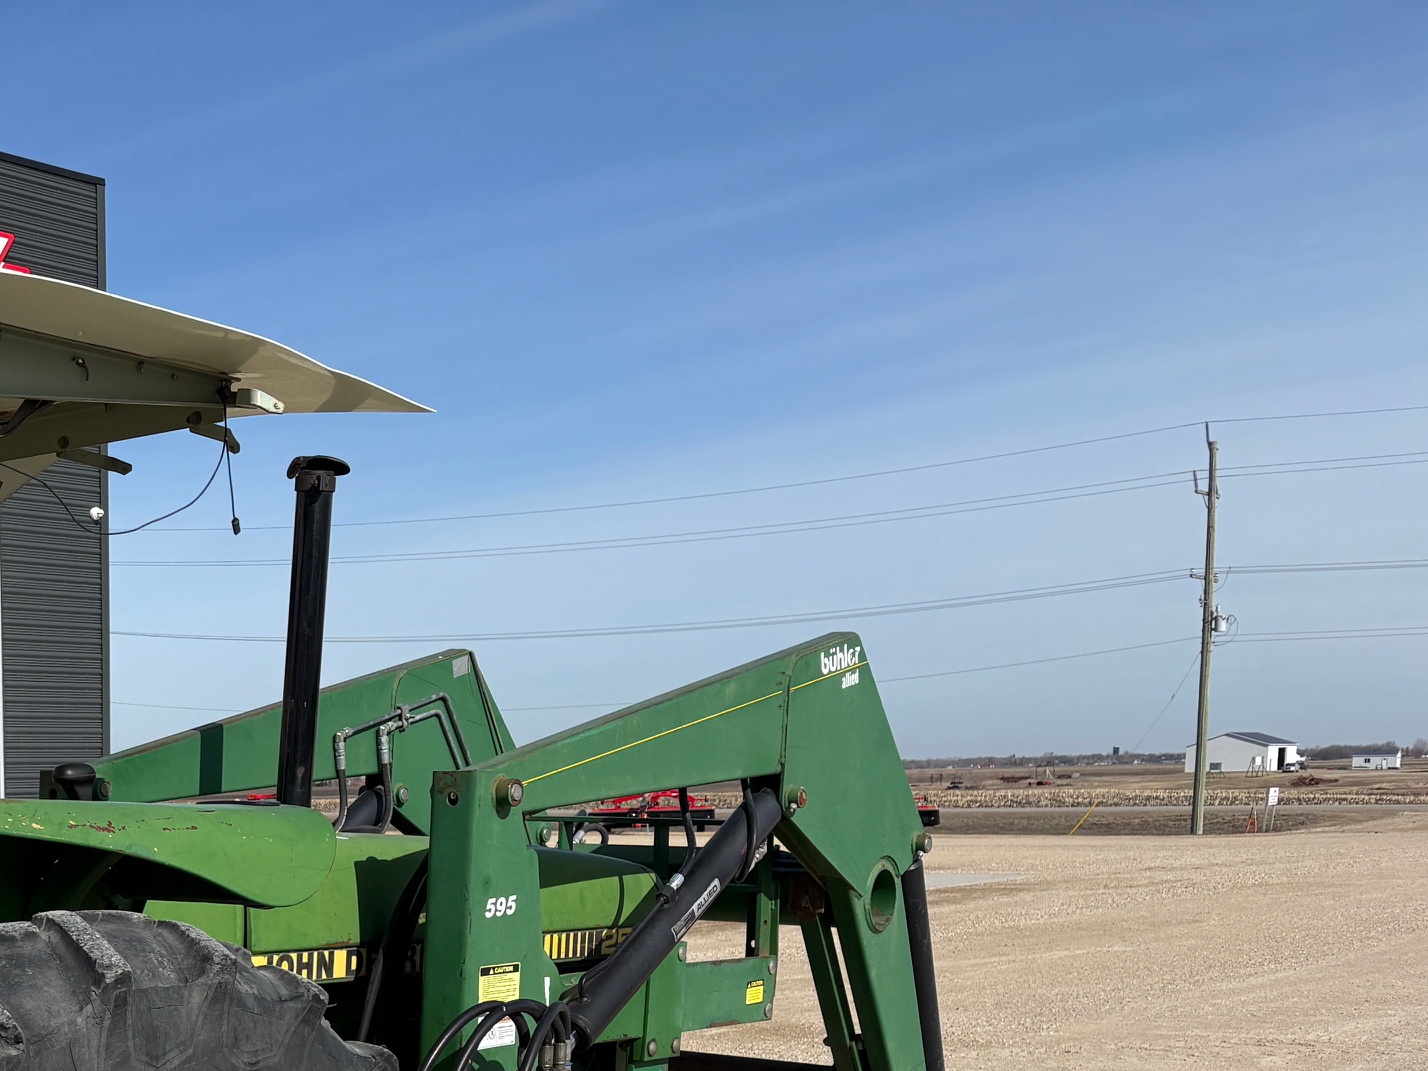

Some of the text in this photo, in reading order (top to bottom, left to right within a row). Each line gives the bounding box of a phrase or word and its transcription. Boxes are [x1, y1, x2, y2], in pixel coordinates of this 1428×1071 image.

[821, 643, 861, 675] bühler
[842, 668, 859, 689] allied
[484, 894, 517, 919] 595
[697, 884, 719, 913] ALLIED
[494, 965, 514, 974] CAUTION
